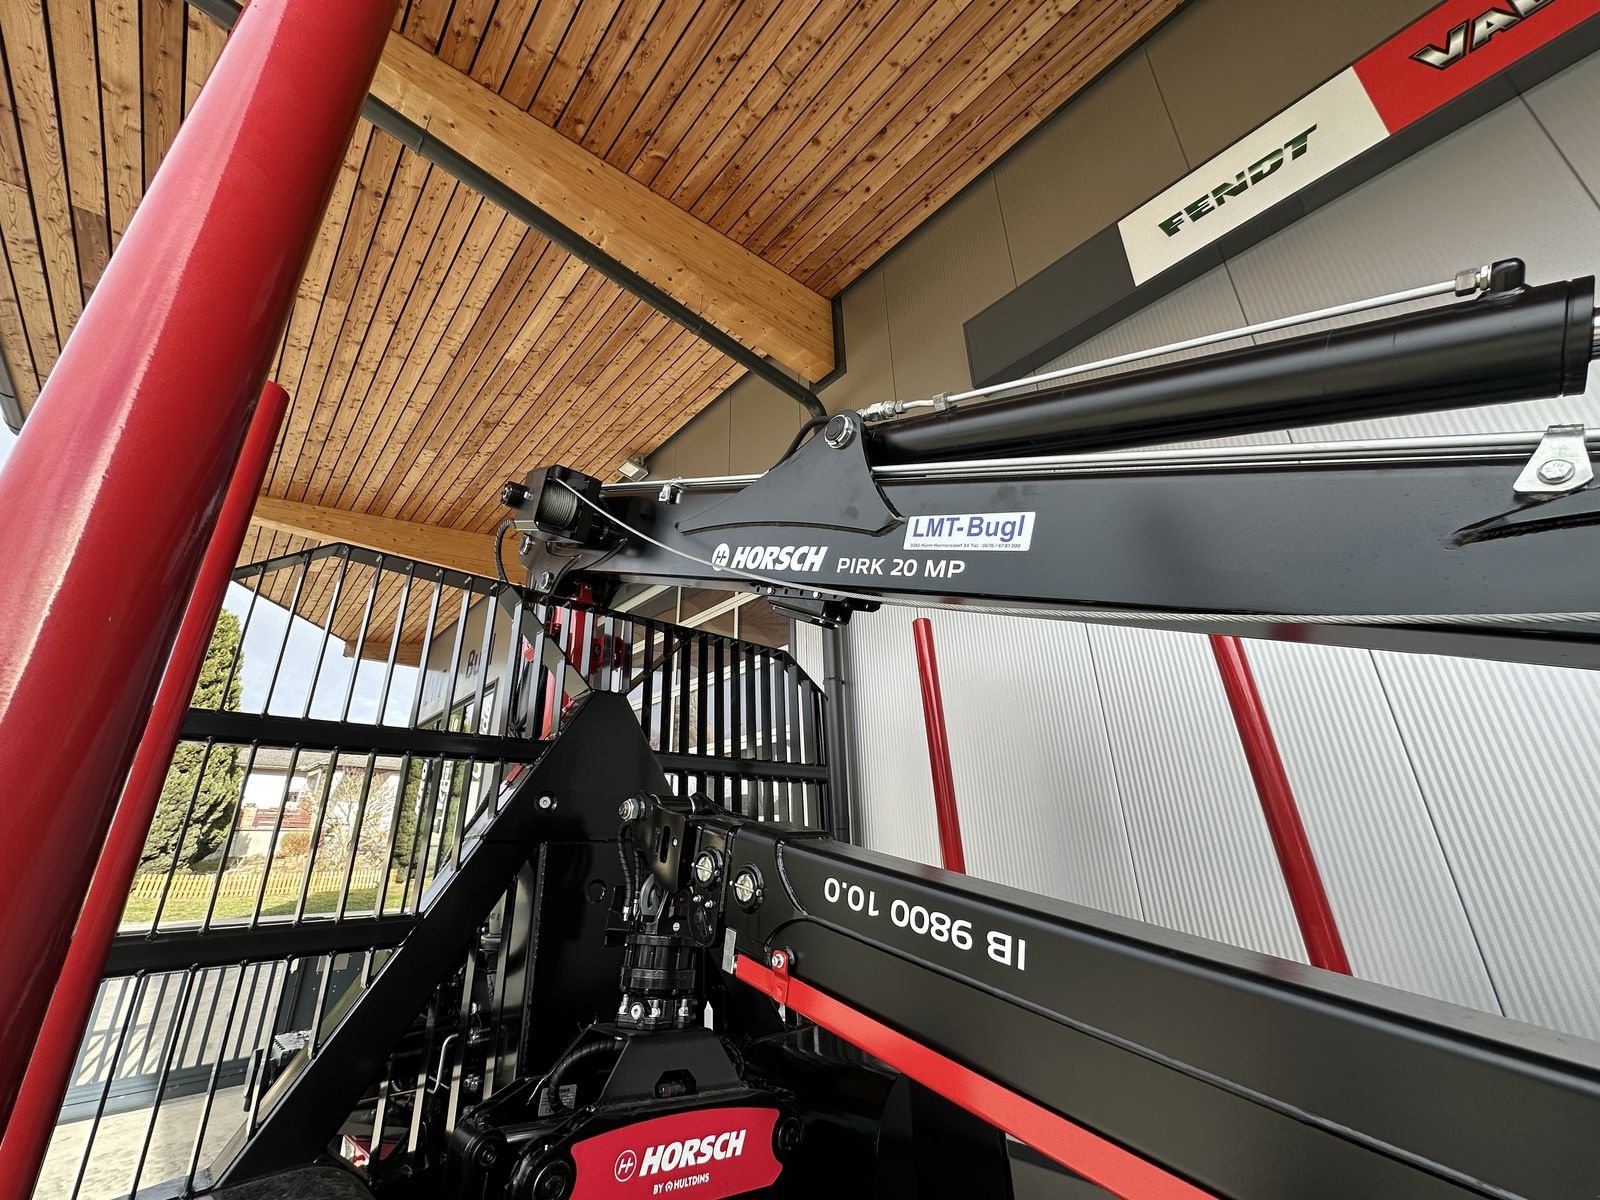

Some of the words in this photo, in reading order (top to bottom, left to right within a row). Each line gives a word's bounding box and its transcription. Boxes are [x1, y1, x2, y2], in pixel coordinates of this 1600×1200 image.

[1157, 123, 1317, 237] FENDT
[912, 515, 1025, 542] LMT-Bugl
[730, 546, 828, 572] HORSCH
[836, 557, 883, 576] PIRK
[890, 559, 917, 577] 20
[924, 560, 965, 578] MP
[824, 877, 880, 917] 10.0
[890, 899, 973, 951] 9800
[986, 930, 1026, 971] IB
[638, 1129, 747, 1177] HORSCH
[653, 1182, 664, 1195] BY
[673, 1173, 710, 1190] HULTDINS
